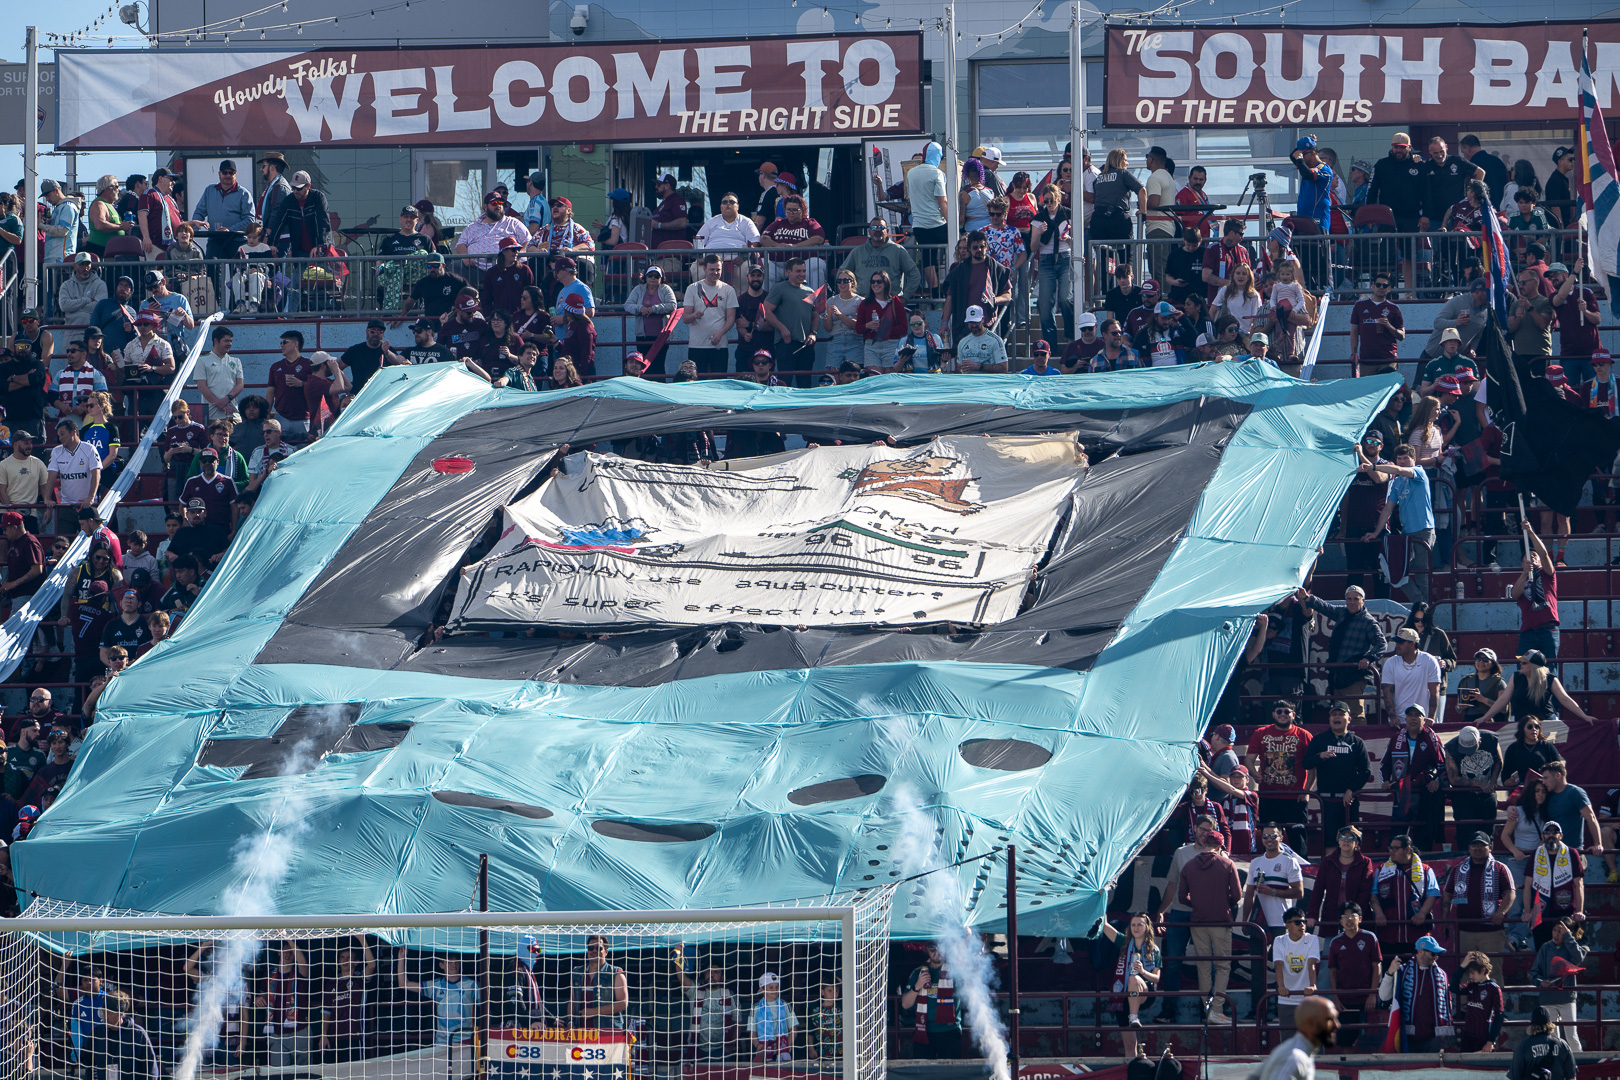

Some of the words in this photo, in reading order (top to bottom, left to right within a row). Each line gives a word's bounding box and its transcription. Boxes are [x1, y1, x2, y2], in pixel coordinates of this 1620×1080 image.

[1123, 30, 1163, 56] The
[1138, 31, 1444, 104] SOUTH
[214, 73, 287, 115] Howdy
[288, 53, 357, 87] Folks!
[285, 45, 752, 143] WELCOME
[786, 39, 901, 108] TO
[676, 109, 732, 134] THE
[738, 106, 828, 132] RIGHT
[832, 103, 902, 130] SIDE
[1135, 99, 1172, 123] OF
[1184, 99, 1244, 123] THE
[1244, 99, 1374, 123] ROCKIES
[494, 559, 635, 583] RAPIDMAN
[79, 614, 94, 638] 7
[512, 1027, 600, 1042] COLORADO
